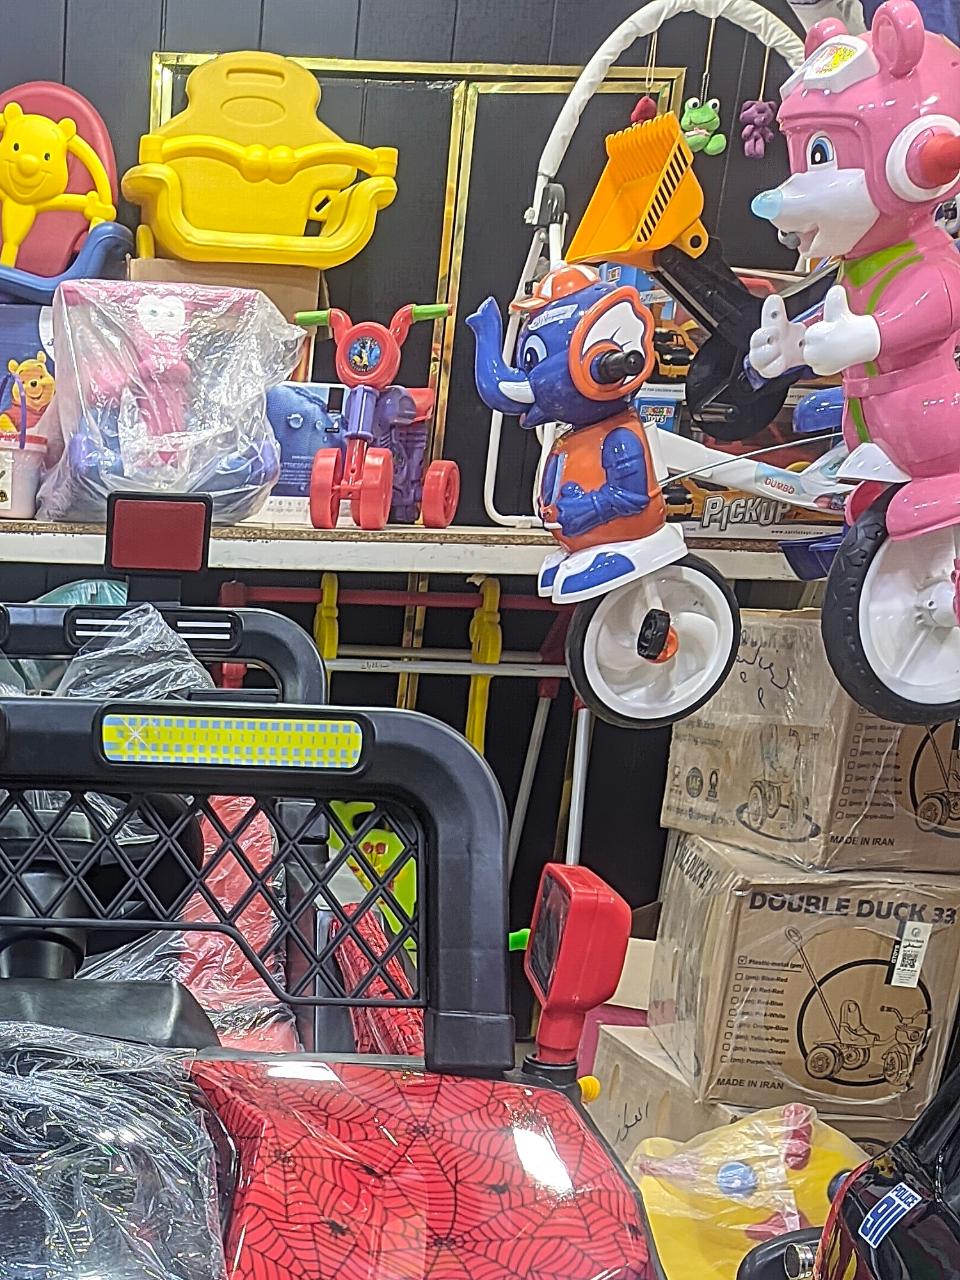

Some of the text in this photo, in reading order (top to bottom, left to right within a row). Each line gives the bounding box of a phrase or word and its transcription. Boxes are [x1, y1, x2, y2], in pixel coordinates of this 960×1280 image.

[765, 477, 795, 495] DUMBO
[829, 835, 895, 847] MADE IN IRAN
[748, 891, 957, 925] DOUBLE DUCK 33
[748, 959, 790, 968] Plastic-metal
[717, 1077, 785, 1090] MADE IN IRAN
[891, 1184, 918, 1208] POLICE
[860, 1195, 907, 1246] 911
